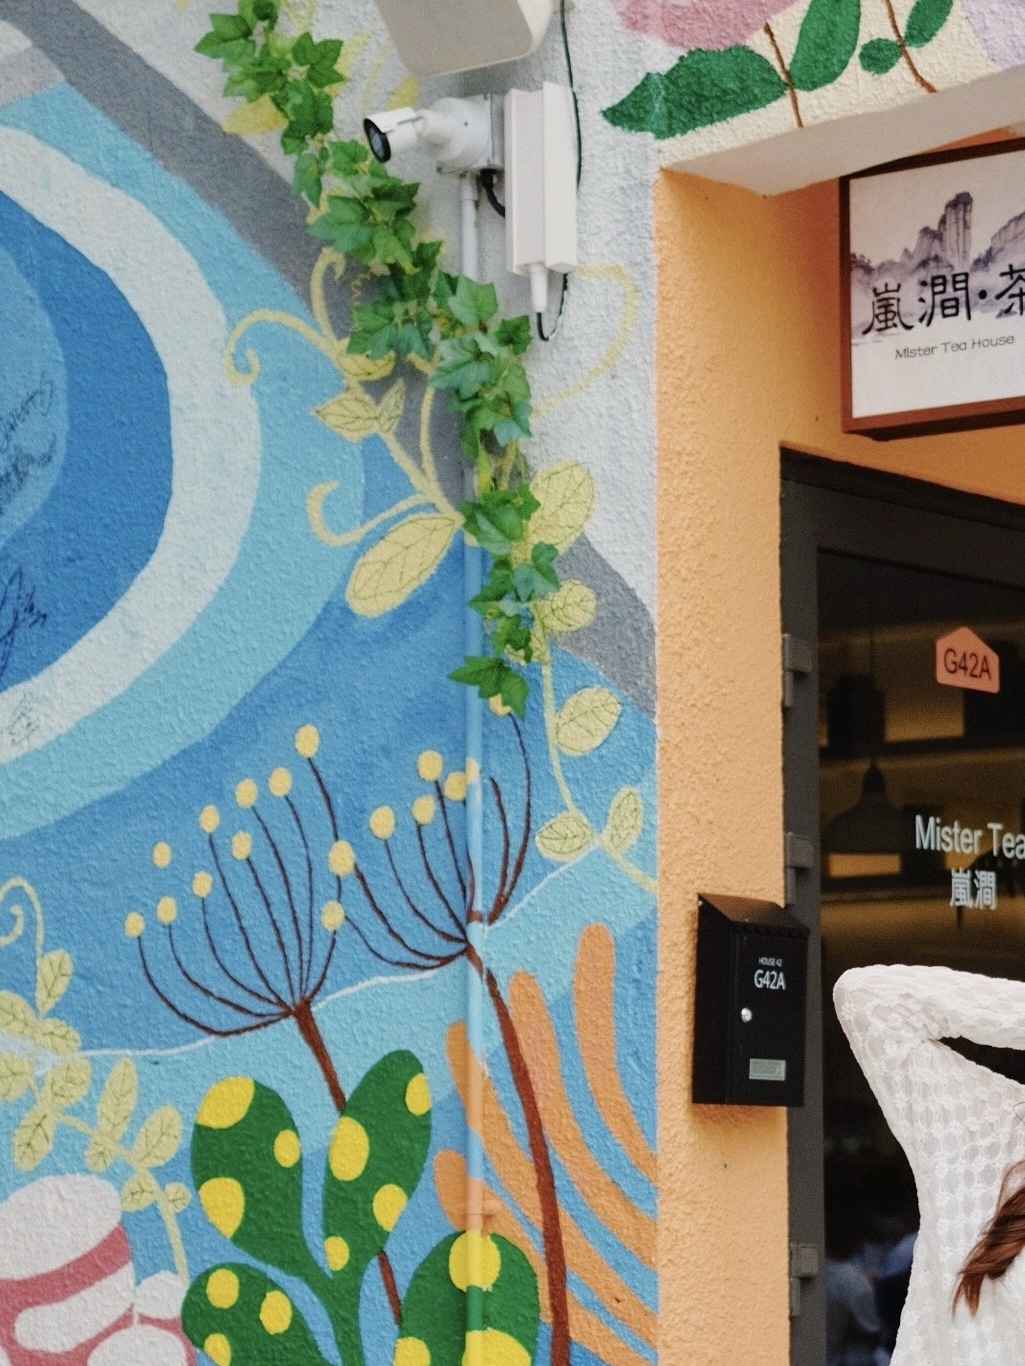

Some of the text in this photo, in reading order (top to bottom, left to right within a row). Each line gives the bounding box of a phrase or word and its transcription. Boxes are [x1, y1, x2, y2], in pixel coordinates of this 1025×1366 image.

[895, 335, 1014, 359] Mister Tea House
[944, 648, 991, 680] G42A
[915, 814, 983, 854] Mister
[949, 867, 997, 910] 嵐澗
[759, 957, 775, 966] HOUSE
[754, 969, 786, 990] G42A
